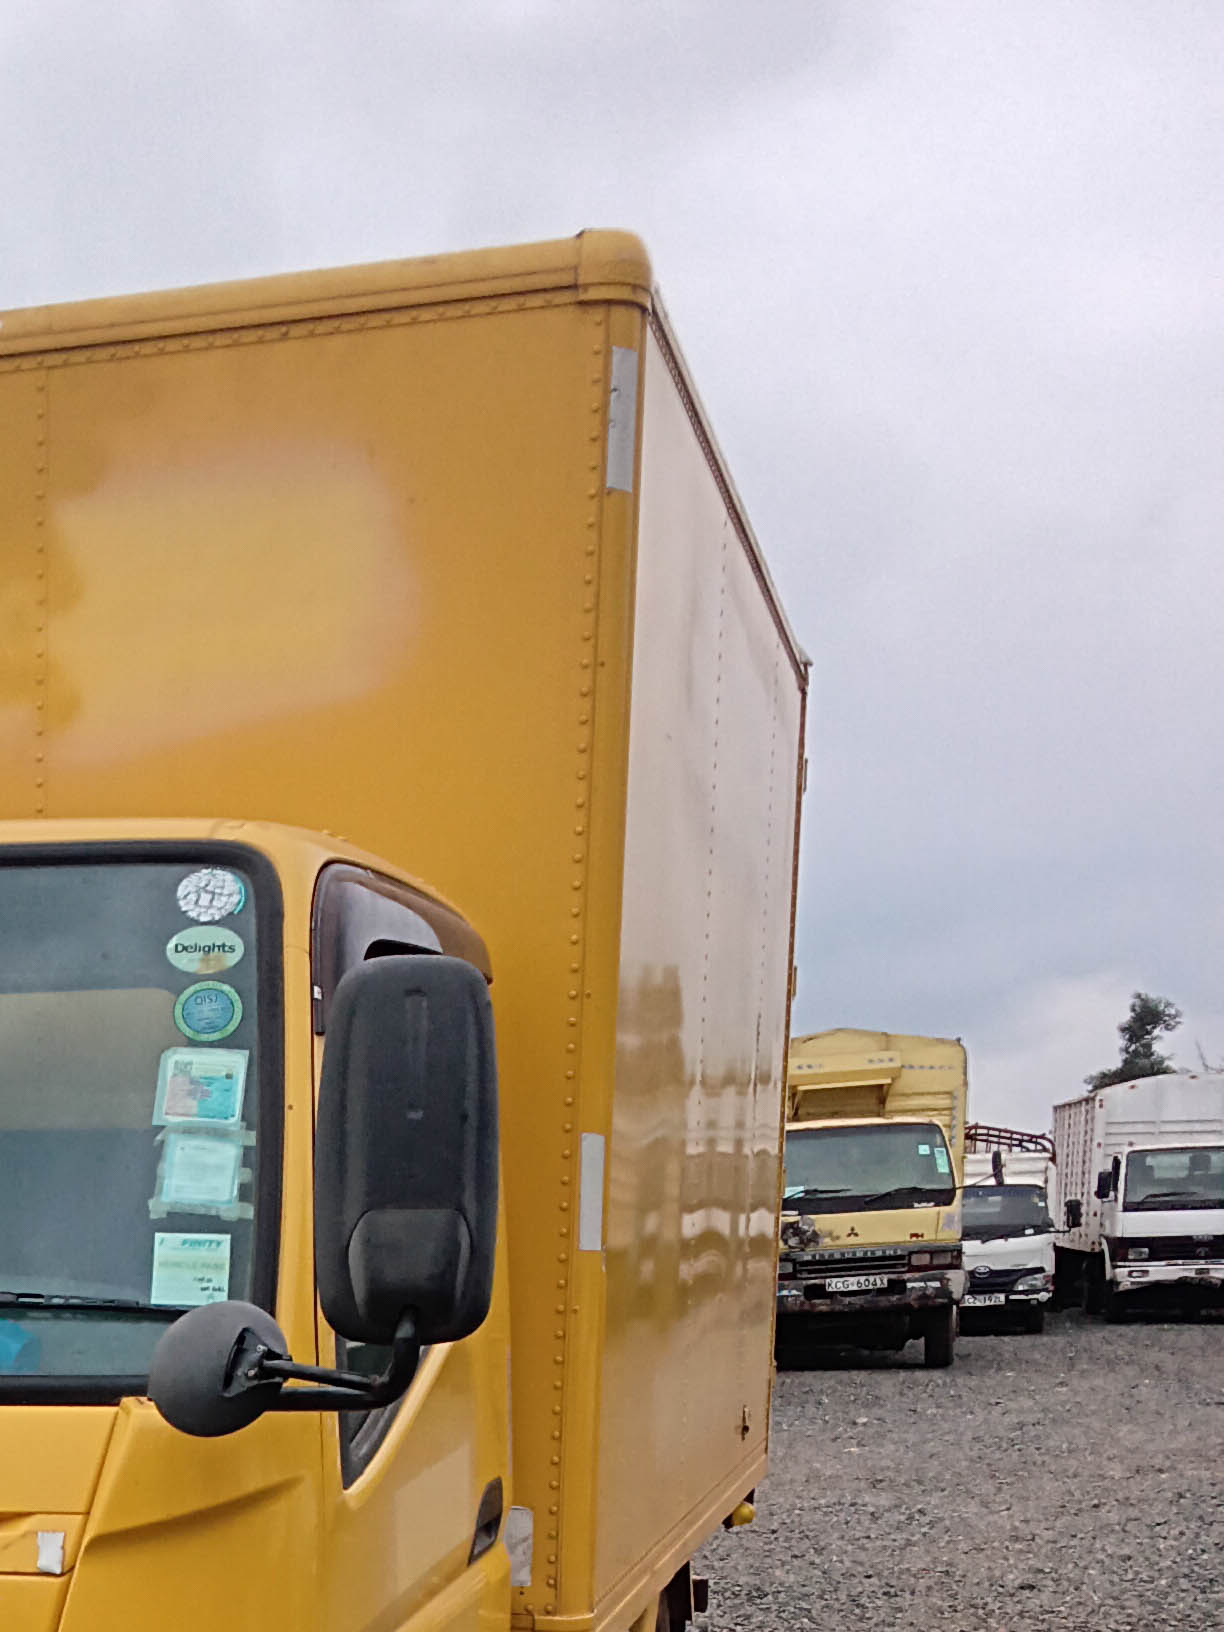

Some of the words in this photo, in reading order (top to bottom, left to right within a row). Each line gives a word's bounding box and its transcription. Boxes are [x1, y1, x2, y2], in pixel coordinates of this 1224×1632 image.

[174, 941, 236, 956] Delights
[827, 1279, 850, 1290] KCG
[856, 1276, 886, 1289] 604X
